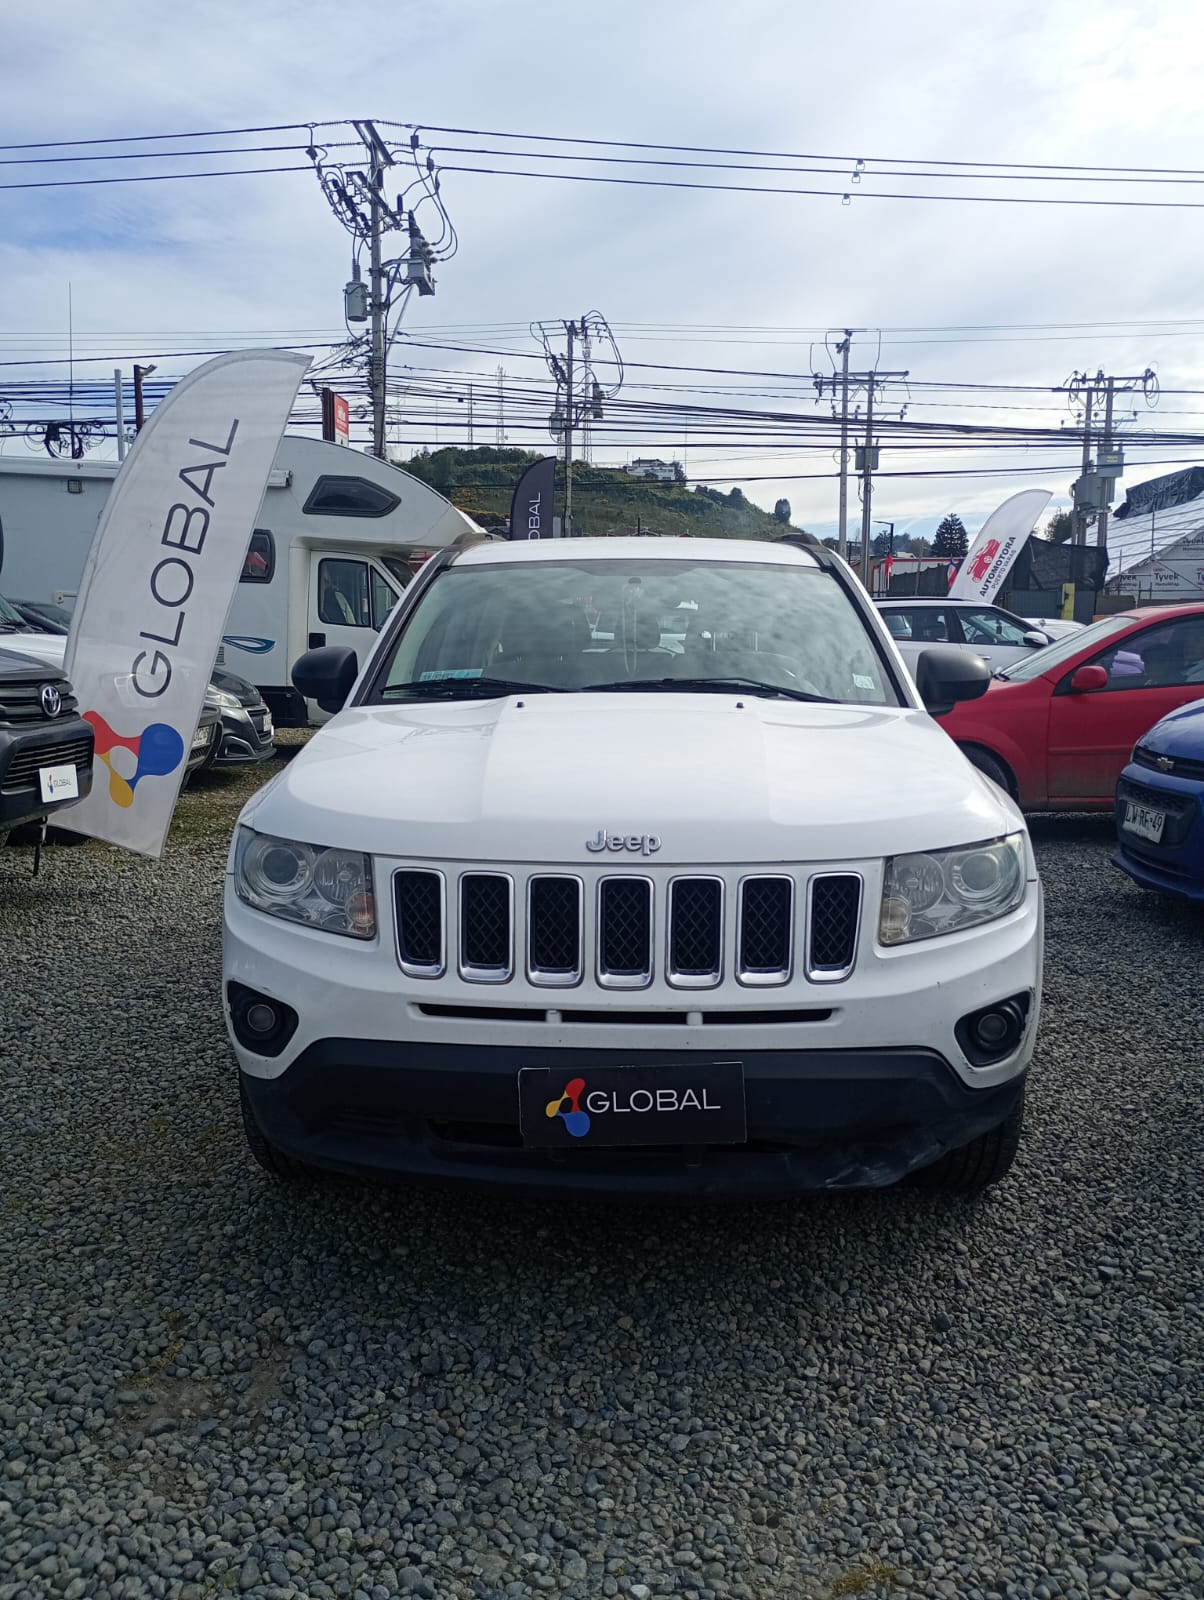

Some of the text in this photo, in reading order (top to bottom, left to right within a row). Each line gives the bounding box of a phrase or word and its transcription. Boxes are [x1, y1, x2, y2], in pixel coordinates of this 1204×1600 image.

[528, 491, 541, 540] OBAL
[132, 418, 239, 699] GLOBAL
[980, 536, 1017, 597] AUTOMOTORA
[991, 567, 1007, 589] PUERTO
[1154, 572, 1179, 582] Tyvek
[585, 829, 662, 856] Jeep
[586, 1088, 721, 1113] GLOBAL
